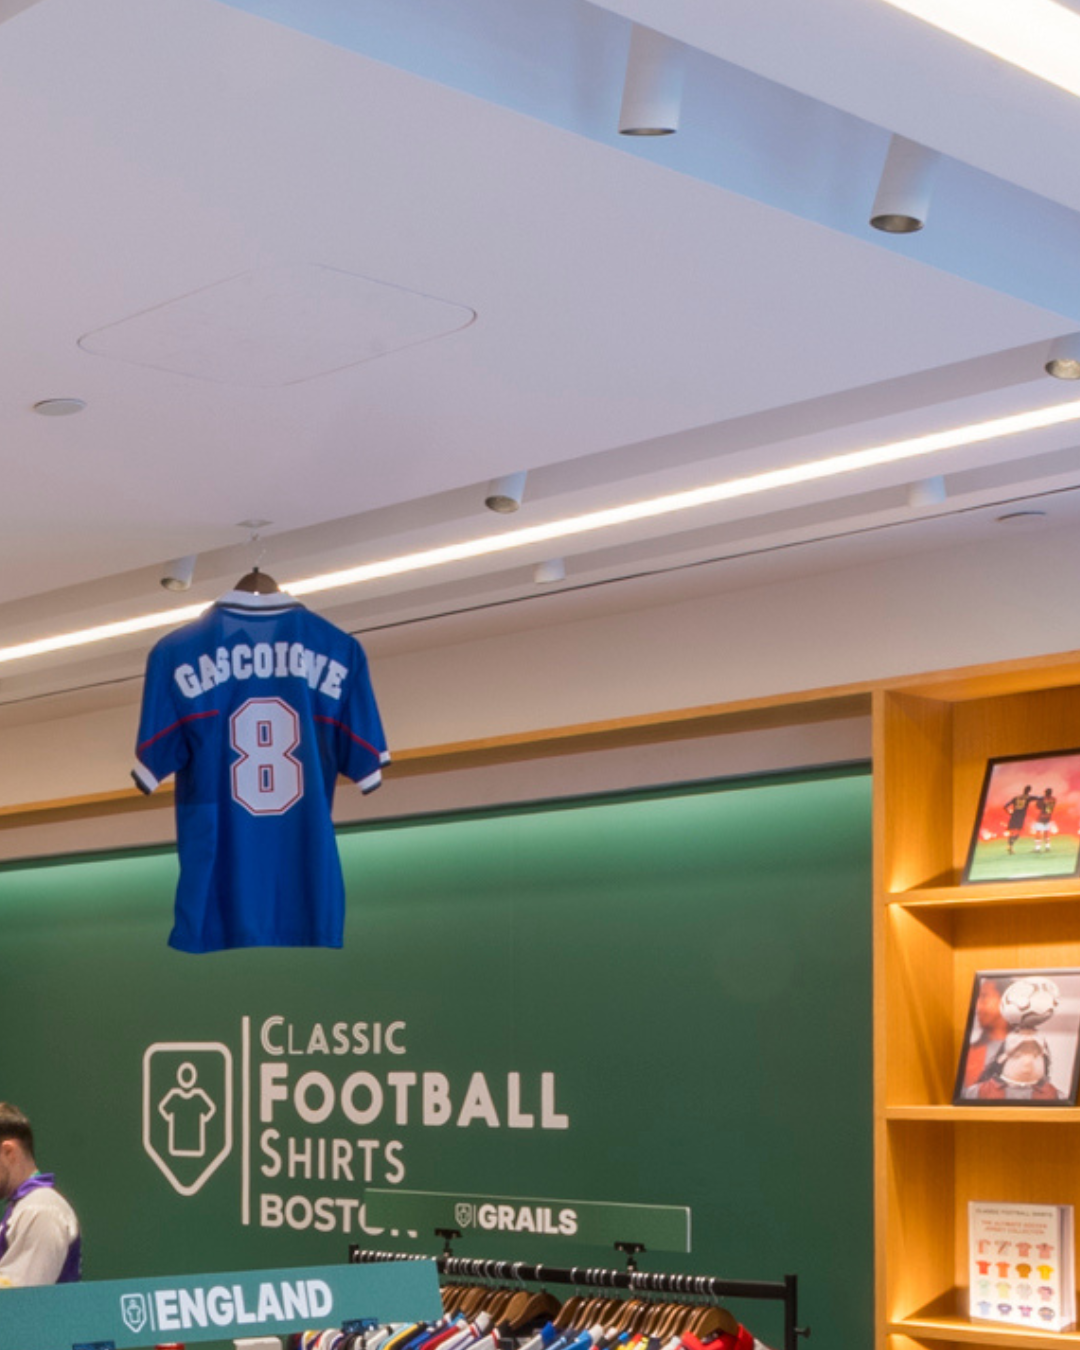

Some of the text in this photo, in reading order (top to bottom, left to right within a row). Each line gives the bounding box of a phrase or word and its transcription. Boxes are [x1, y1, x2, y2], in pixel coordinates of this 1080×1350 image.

[174, 642, 348, 700] GASCOIGNE
[229, 696, 304, 816] 8
[259, 1015, 407, 1056] CLASSIC
[259, 1062, 570, 1129] FOOTBALL
[259, 1129, 406, 1184] SHIRTS
[259, 1193, 418, 1238] BOST
[477, 1203, 579, 1235] GRAILS
[154, 1279, 334, 1331] ENGLAND
